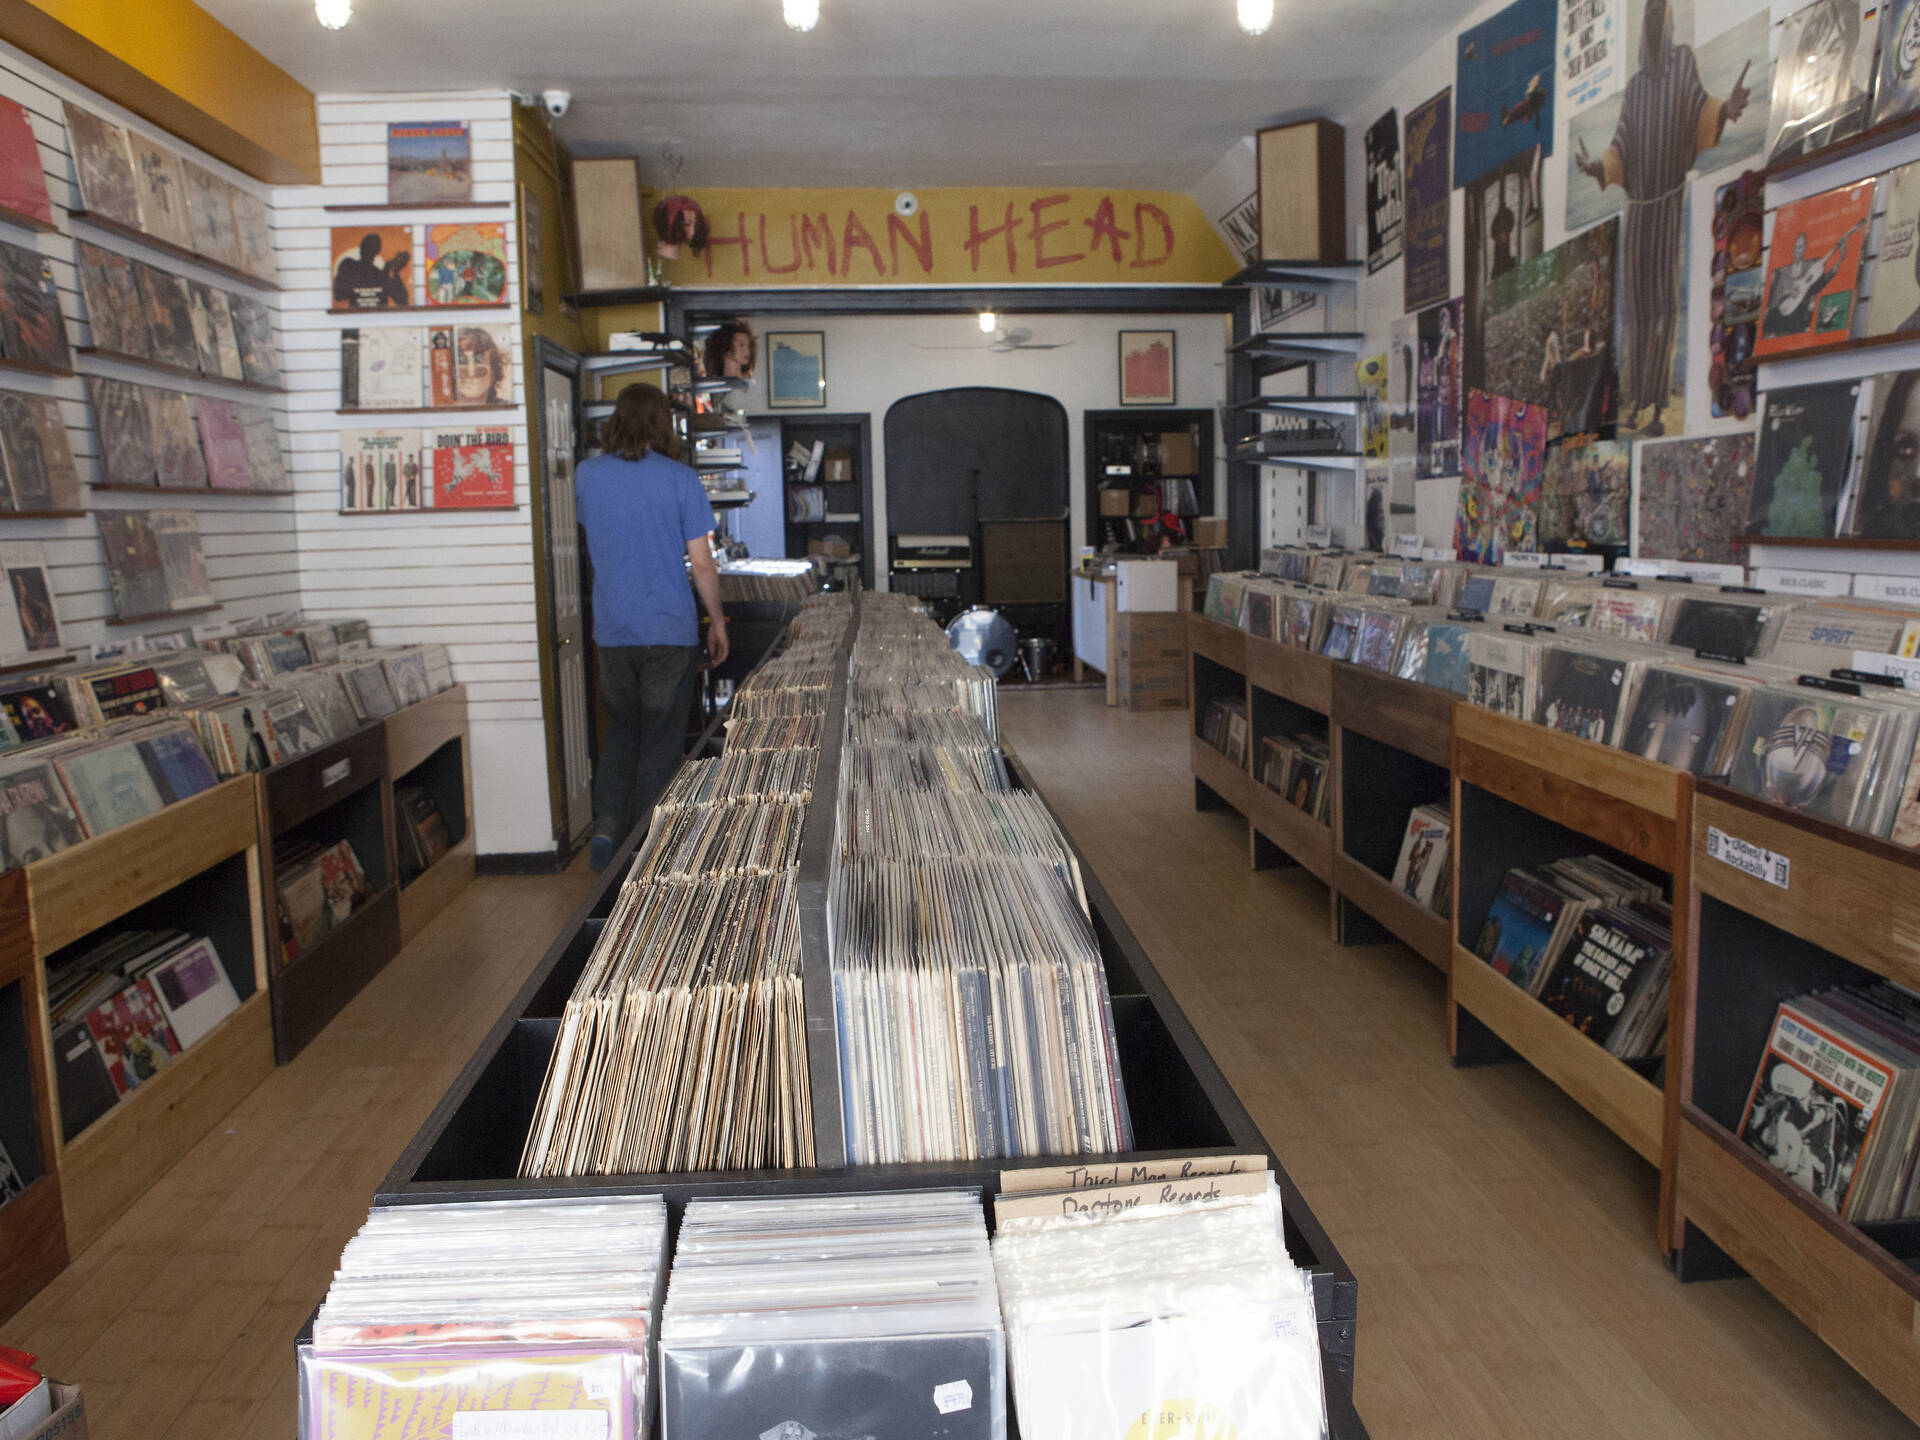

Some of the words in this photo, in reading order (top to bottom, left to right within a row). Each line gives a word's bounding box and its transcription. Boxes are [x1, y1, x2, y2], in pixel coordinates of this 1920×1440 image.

[704, 211, 934, 278] HUMAN
[963, 195, 1175, 273] HEAD
[466, 432, 482, 447] THE
[485, 432, 509, 446] BIRD
[1809, 627, 1854, 645] SPIRIT
